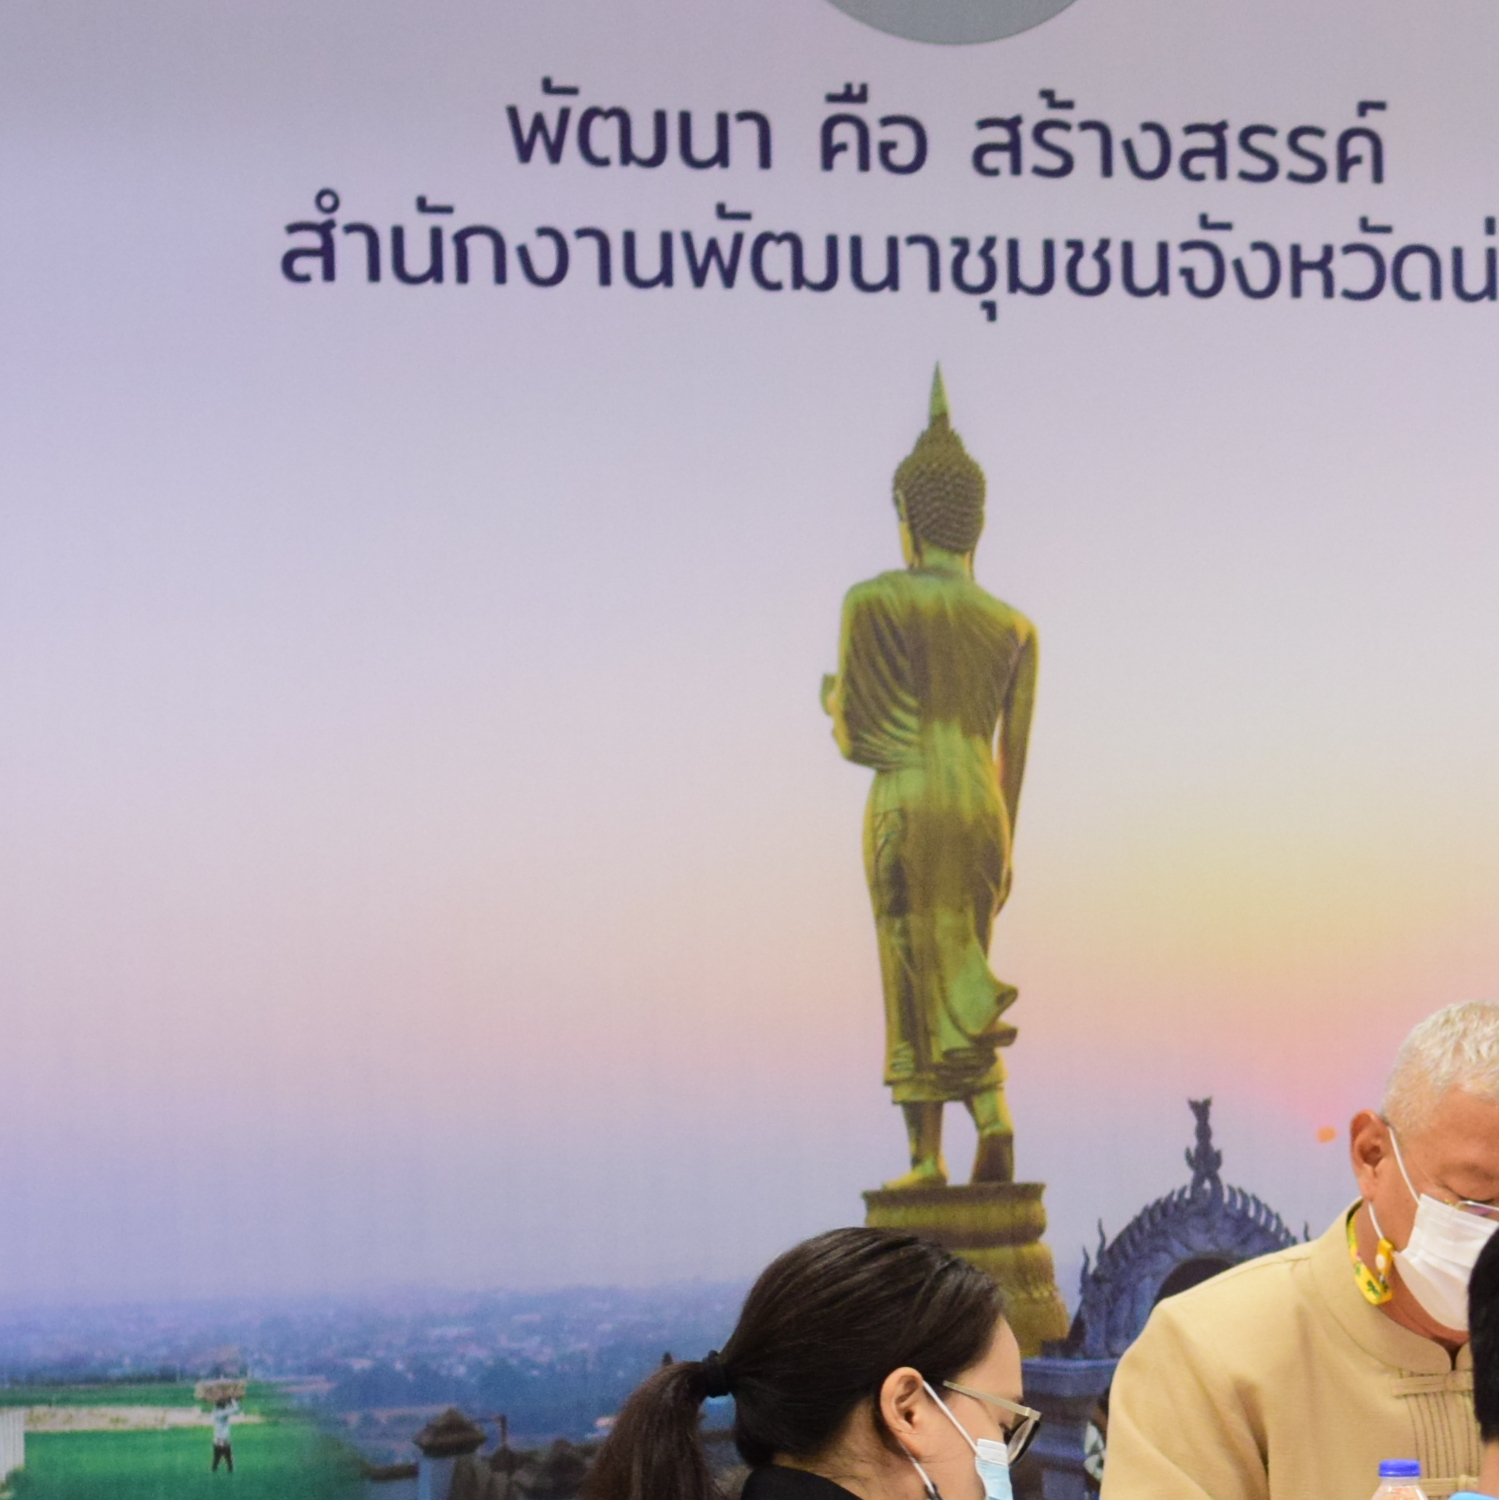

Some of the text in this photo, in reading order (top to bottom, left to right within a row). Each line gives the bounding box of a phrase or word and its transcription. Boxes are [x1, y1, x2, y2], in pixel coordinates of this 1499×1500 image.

[506, 76, 1388, 186] พัฒนา คือ สร้างสรรค์
